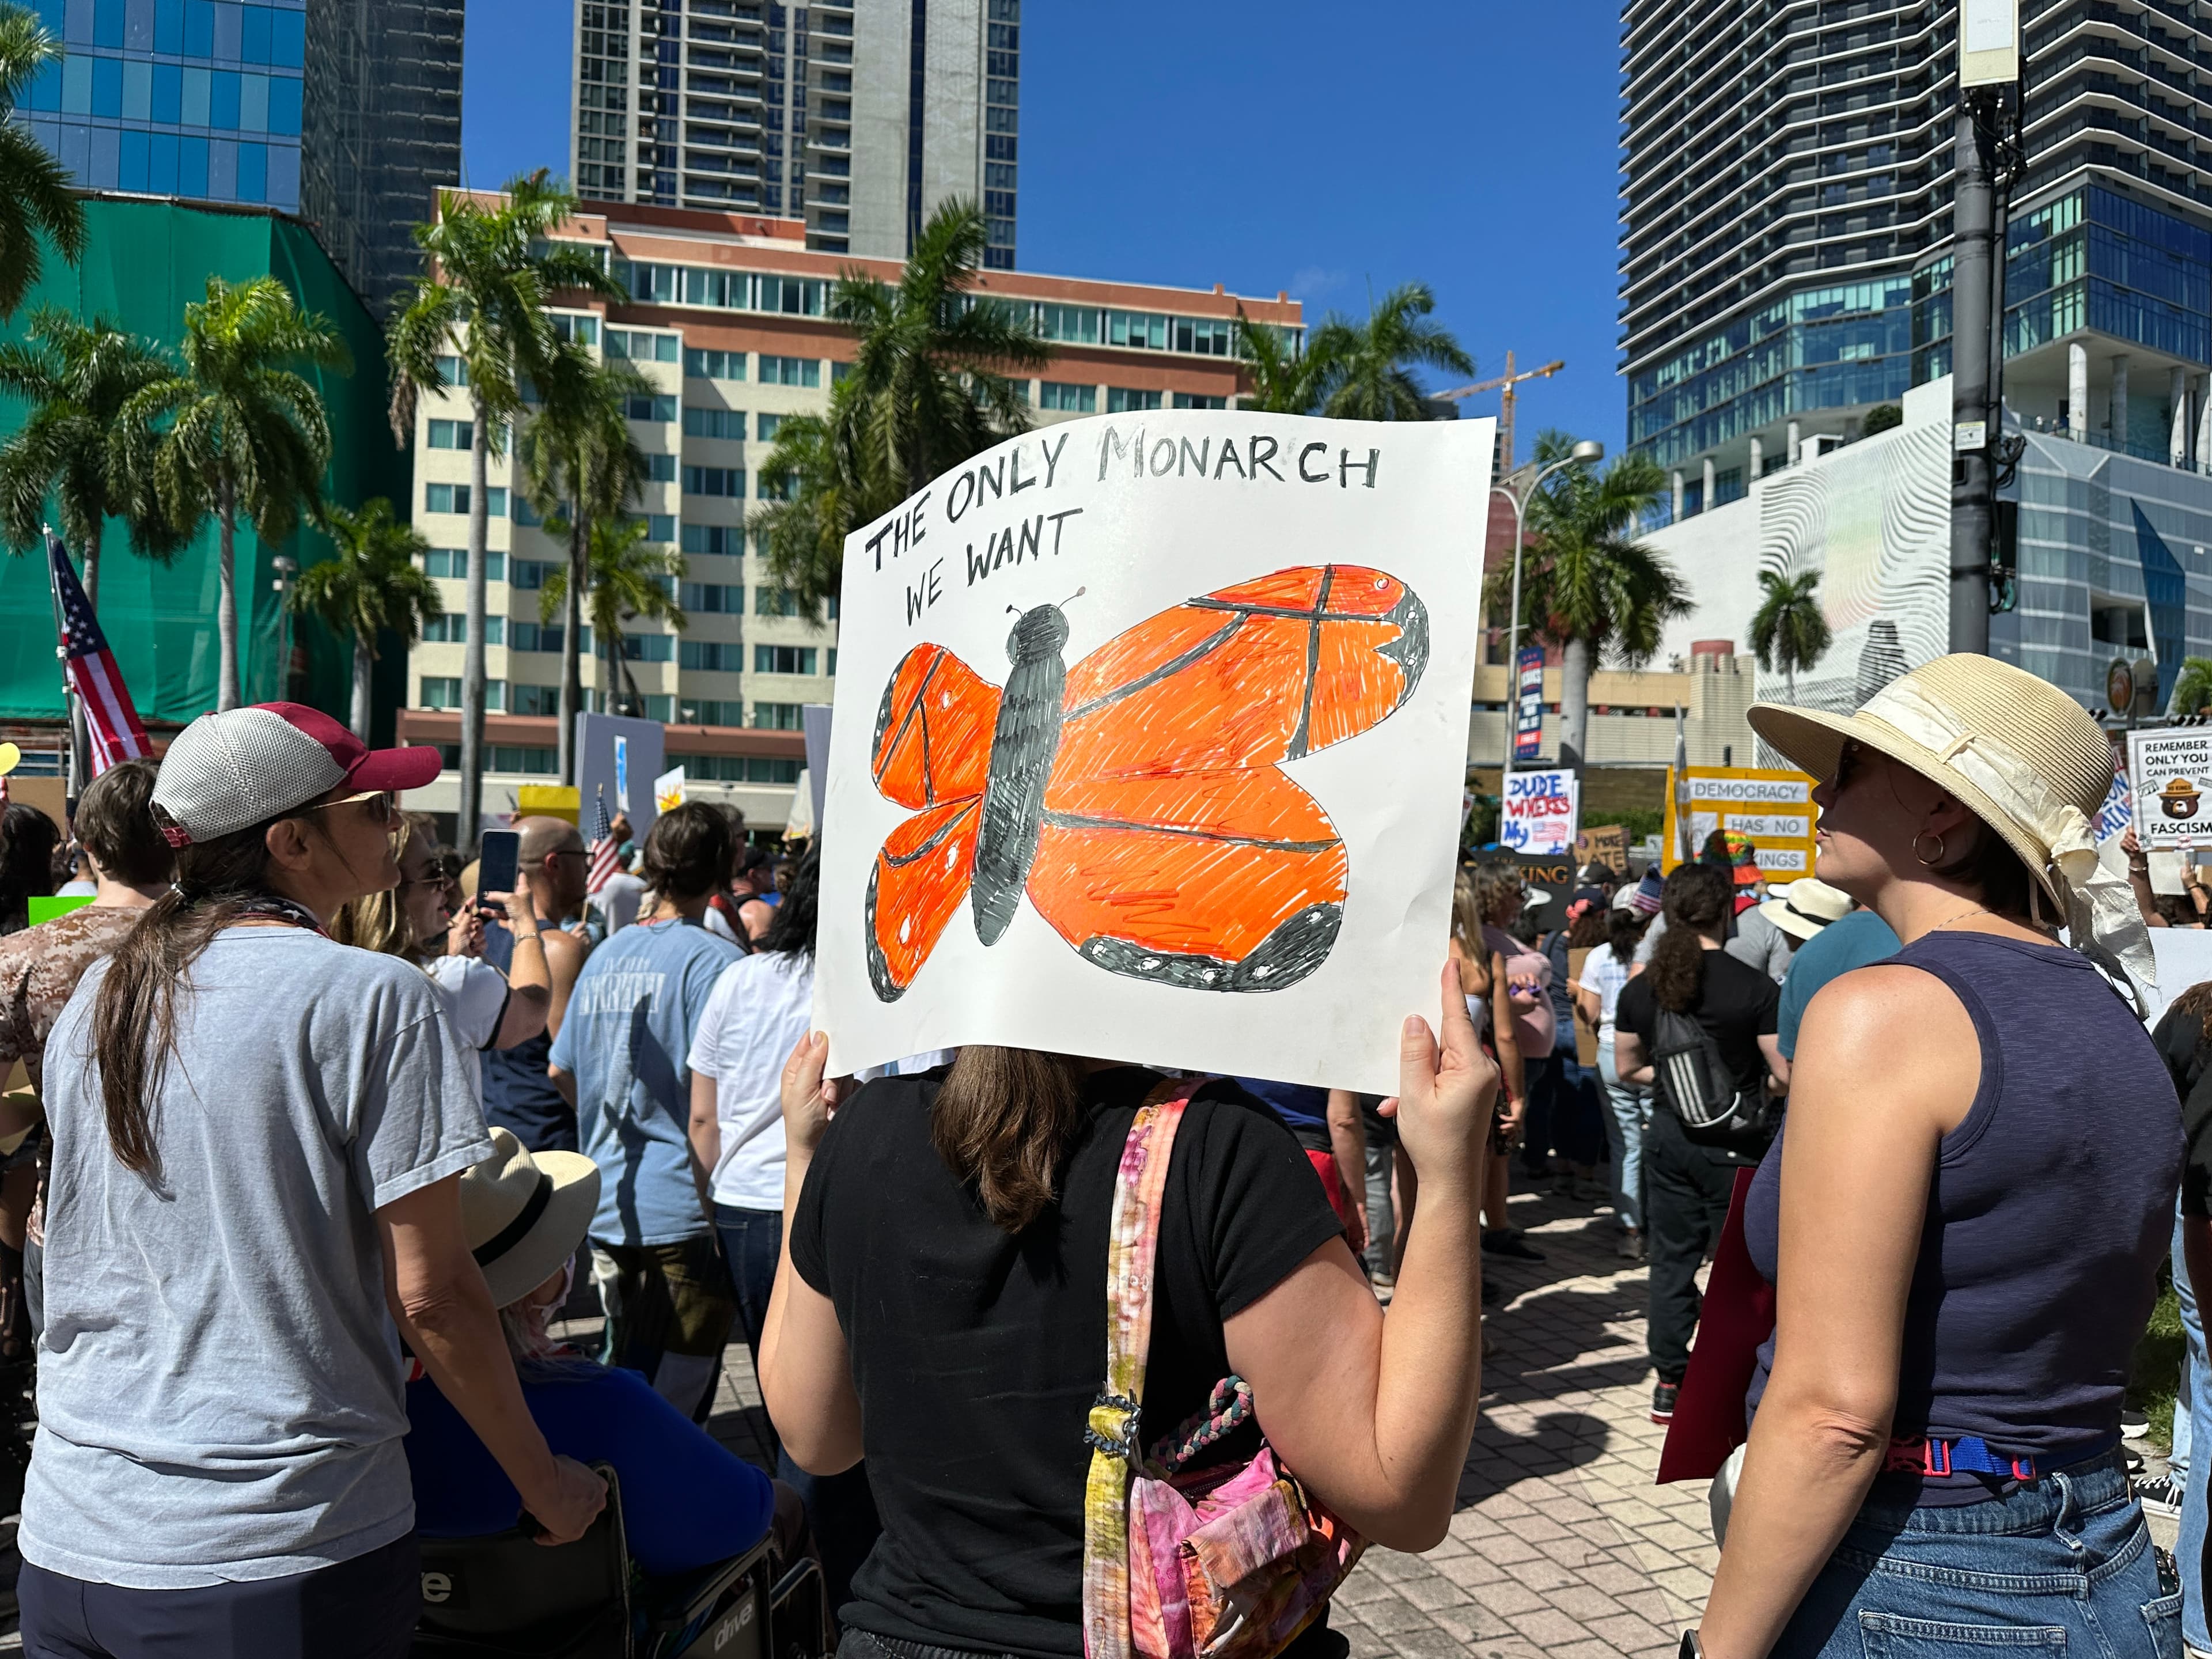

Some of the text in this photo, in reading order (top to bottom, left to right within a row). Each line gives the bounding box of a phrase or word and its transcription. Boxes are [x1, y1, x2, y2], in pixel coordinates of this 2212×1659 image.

[865, 423, 1380, 572] THE ONLY MONARCH
[907, 507, 1083, 627] WE WANT
[2145, 741, 2208, 753] REMEMBER
[2145, 753, 2208, 765] ONLY YOU
[2146, 767, 2209, 777] CAN PREVENT
[1695, 782, 1798, 800] DEMOCRACY
[1732, 819, 1800, 834] HAS NO
[2151, 823, 2212, 834] FASCISM
